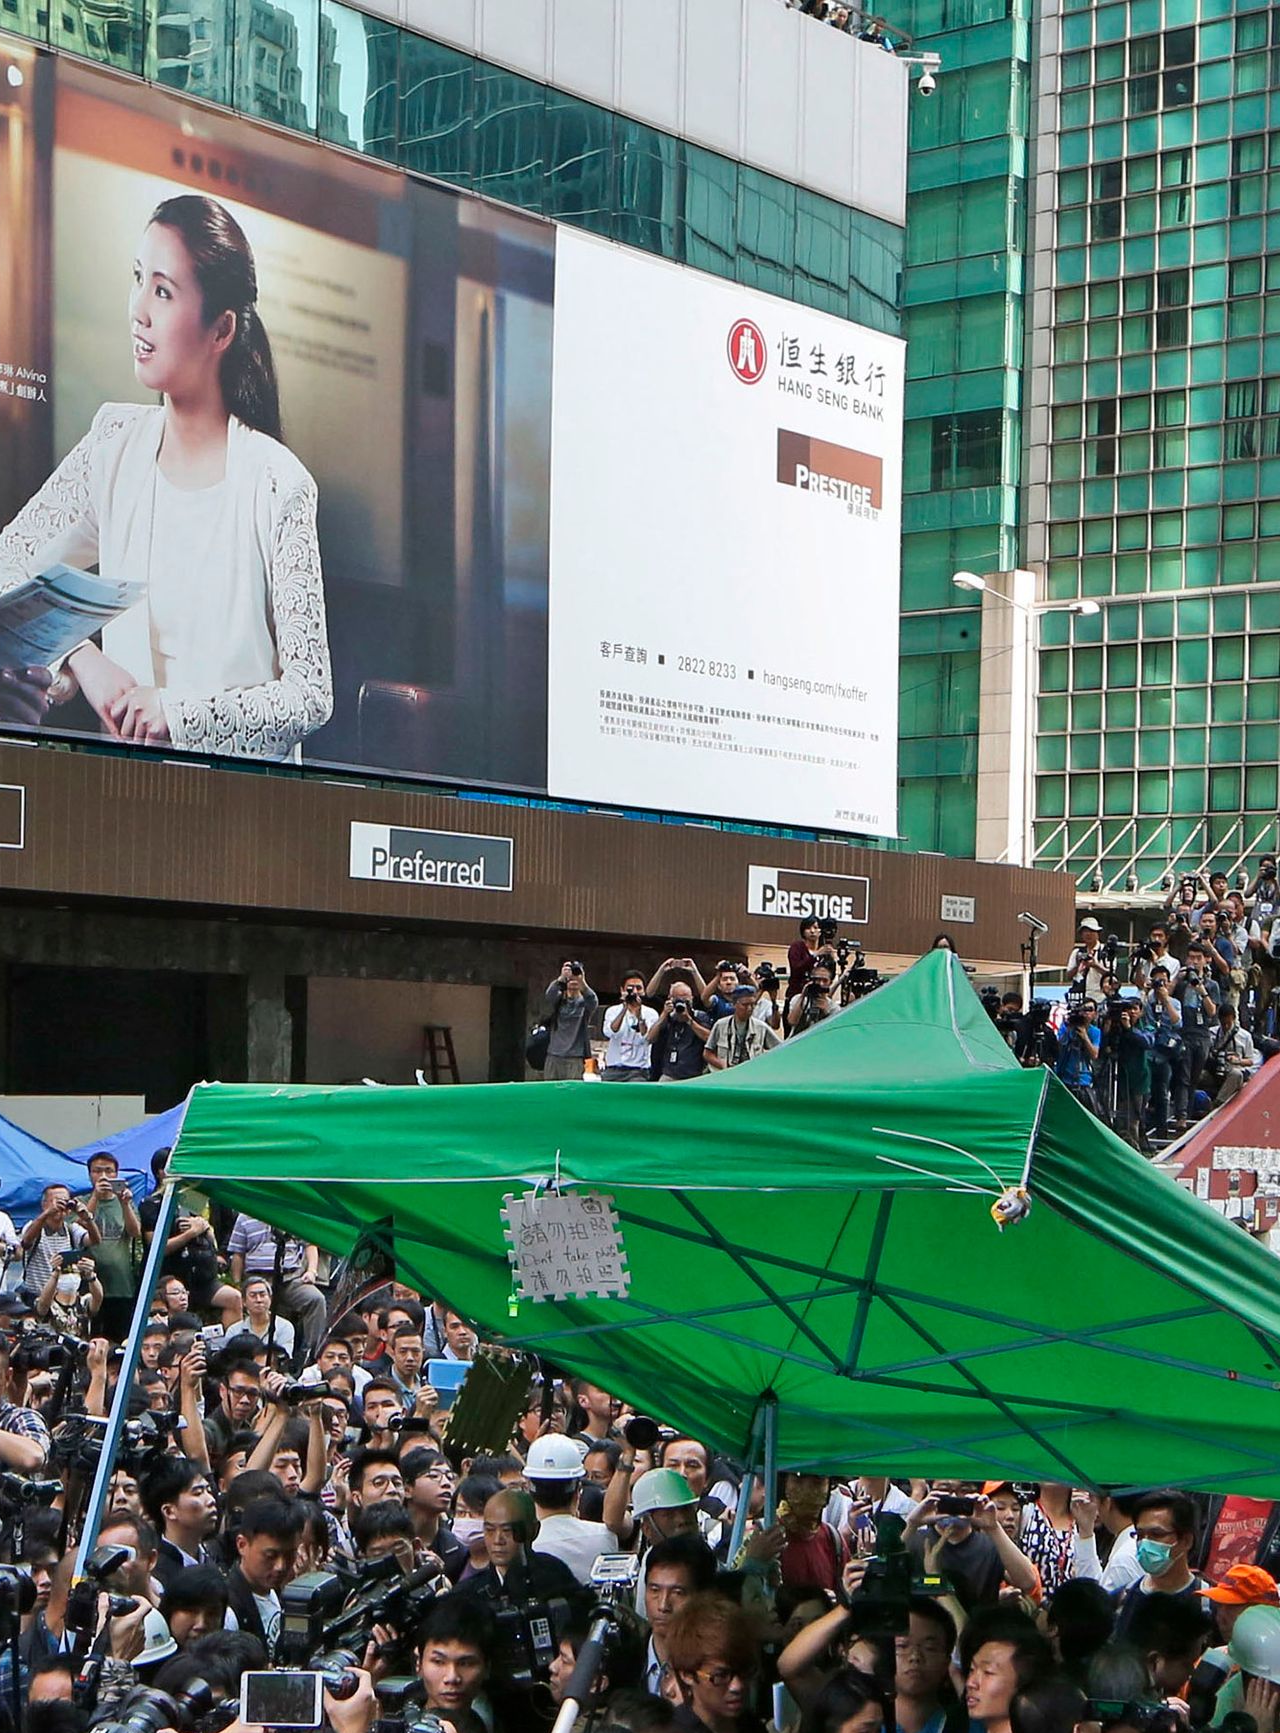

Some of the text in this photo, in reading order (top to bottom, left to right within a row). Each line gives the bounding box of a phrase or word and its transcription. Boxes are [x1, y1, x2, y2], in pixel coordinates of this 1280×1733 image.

[15, 367, 47, 383] Alvina
[777, 331, 887, 397] 恒生銀行
[777, 375, 885, 422] HANG SENG BANK
[796, 463, 872, 505] PRESTIGE
[599, 640, 869, 703] 客戶查詢 2822 8233 hangseng.com/fxoffer
[371, 846, 485, 887] Preferred
[762, 883, 854, 920] PRESTIGE
